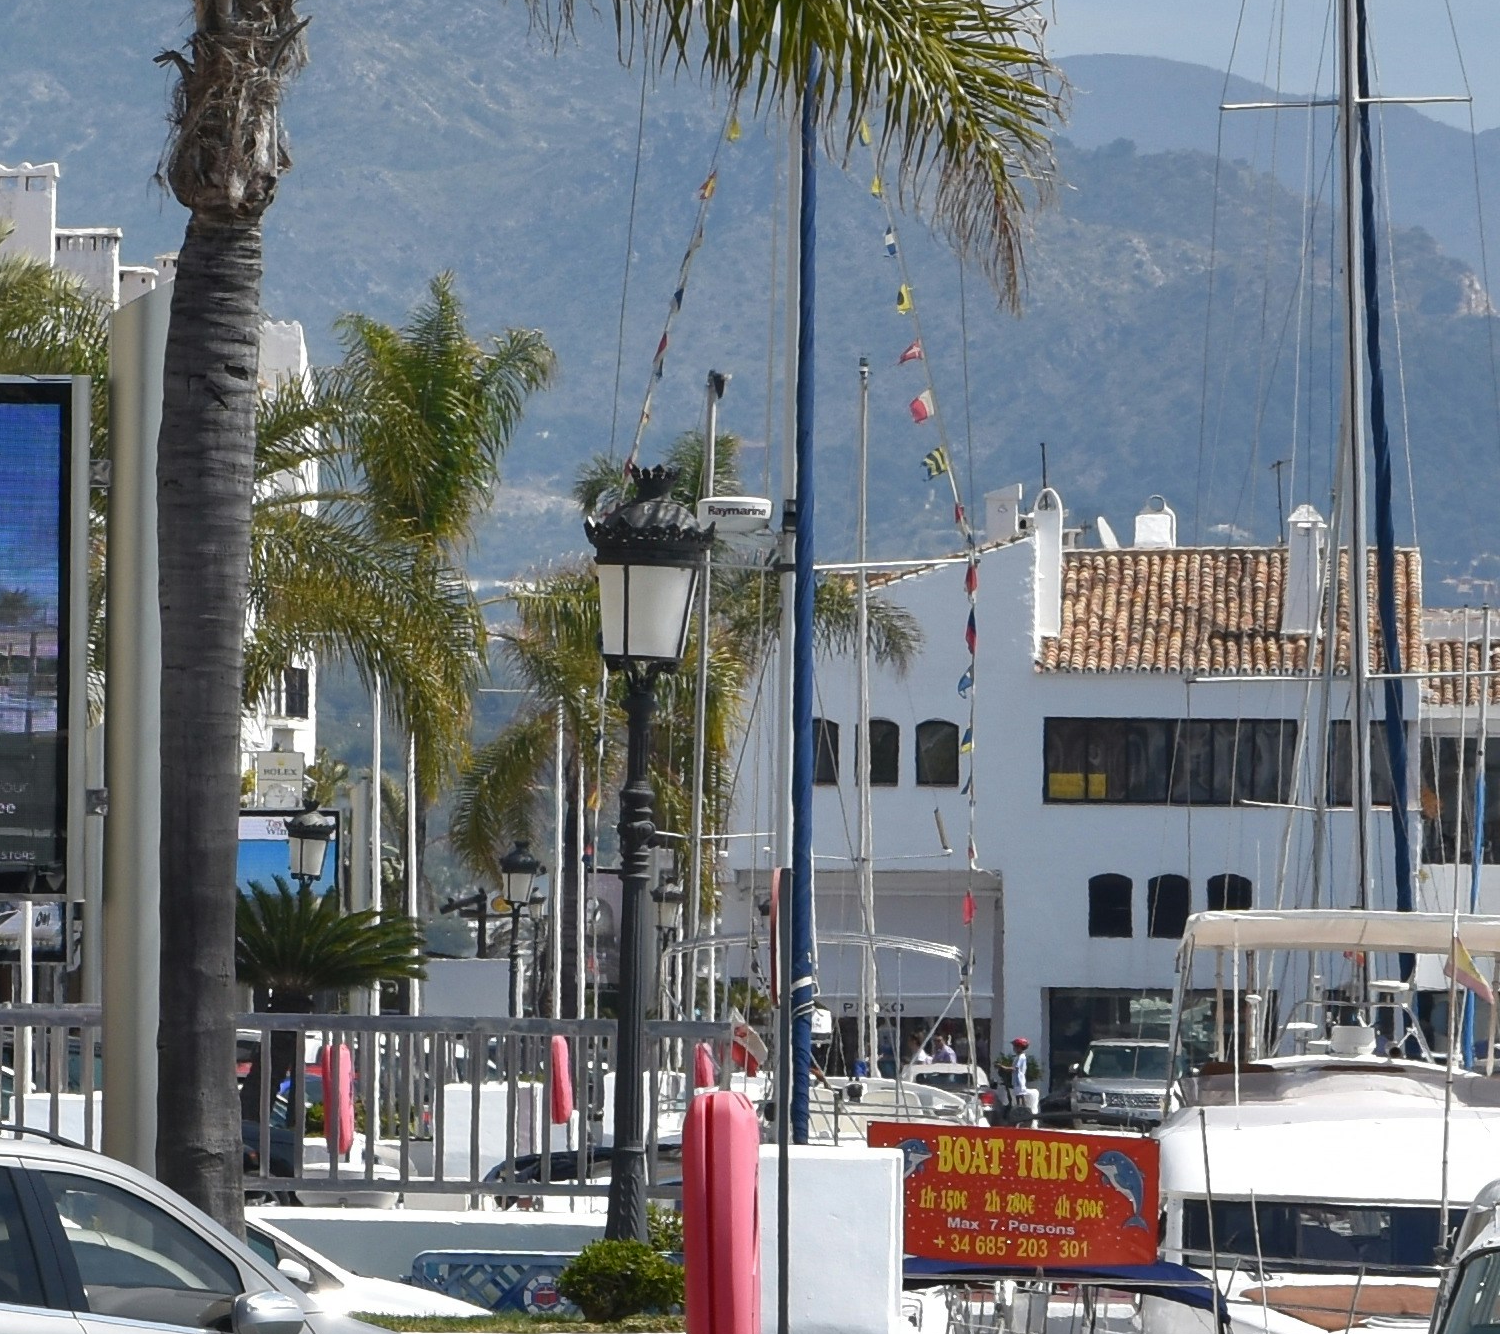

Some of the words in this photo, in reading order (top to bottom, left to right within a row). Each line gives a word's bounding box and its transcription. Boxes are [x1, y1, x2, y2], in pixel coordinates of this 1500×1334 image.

[708, 504, 767, 517] Raymarine
[263, 768, 297, 776] ROLEX
[937, 1135, 1004, 1175] BOAT
[1014, 1139, 1089, 1183] TRIPS
[940, 1189, 968, 1212] 150€
[985, 1188, 1000, 1213] 2h
[1054, 1194, 1071, 1220] 4h
[1076, 1198, 1104, 1221] 500€
[947, 1217, 980, 1231] Max
[989, 1219, 999, 1231] 7
[1008, 1219, 1075, 1236] Persons
[950, 1233, 970, 1254] 34
[975, 1235, 1007, 1256] 685
[1016, 1237, 1049, 1258] 203
[1058, 1239, 1088, 1258] 301
